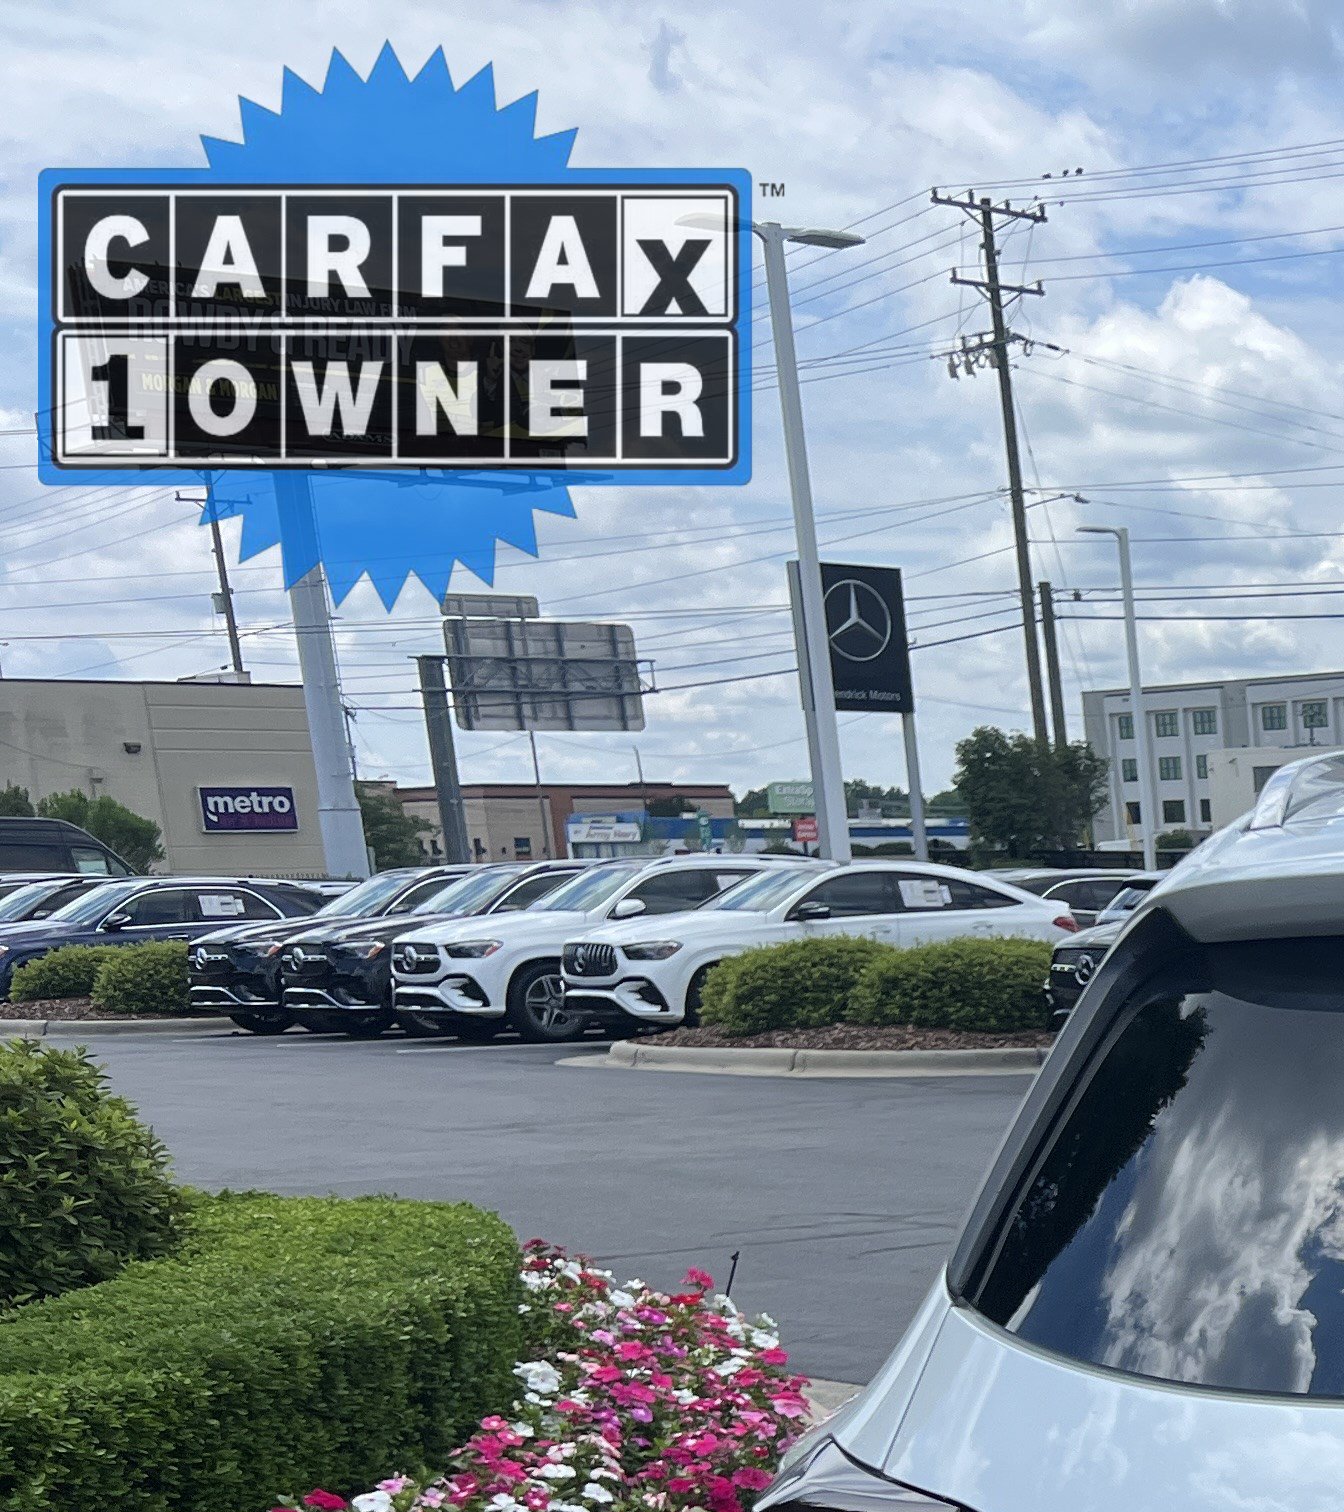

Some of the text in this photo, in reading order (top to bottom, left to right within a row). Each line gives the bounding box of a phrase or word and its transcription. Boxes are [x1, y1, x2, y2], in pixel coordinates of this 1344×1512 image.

[286, 294, 340, 312] INJURY
[345, 301, 377, 316] LAW
[380, 303, 417, 320] FIRM
[128, 297, 265, 351] ROWDY
[304, 314, 418, 366] READY
[142, 373, 201, 394] MORGAN
[220, 379, 278, 399] MORGAN
[206, 792, 291, 822] metro
